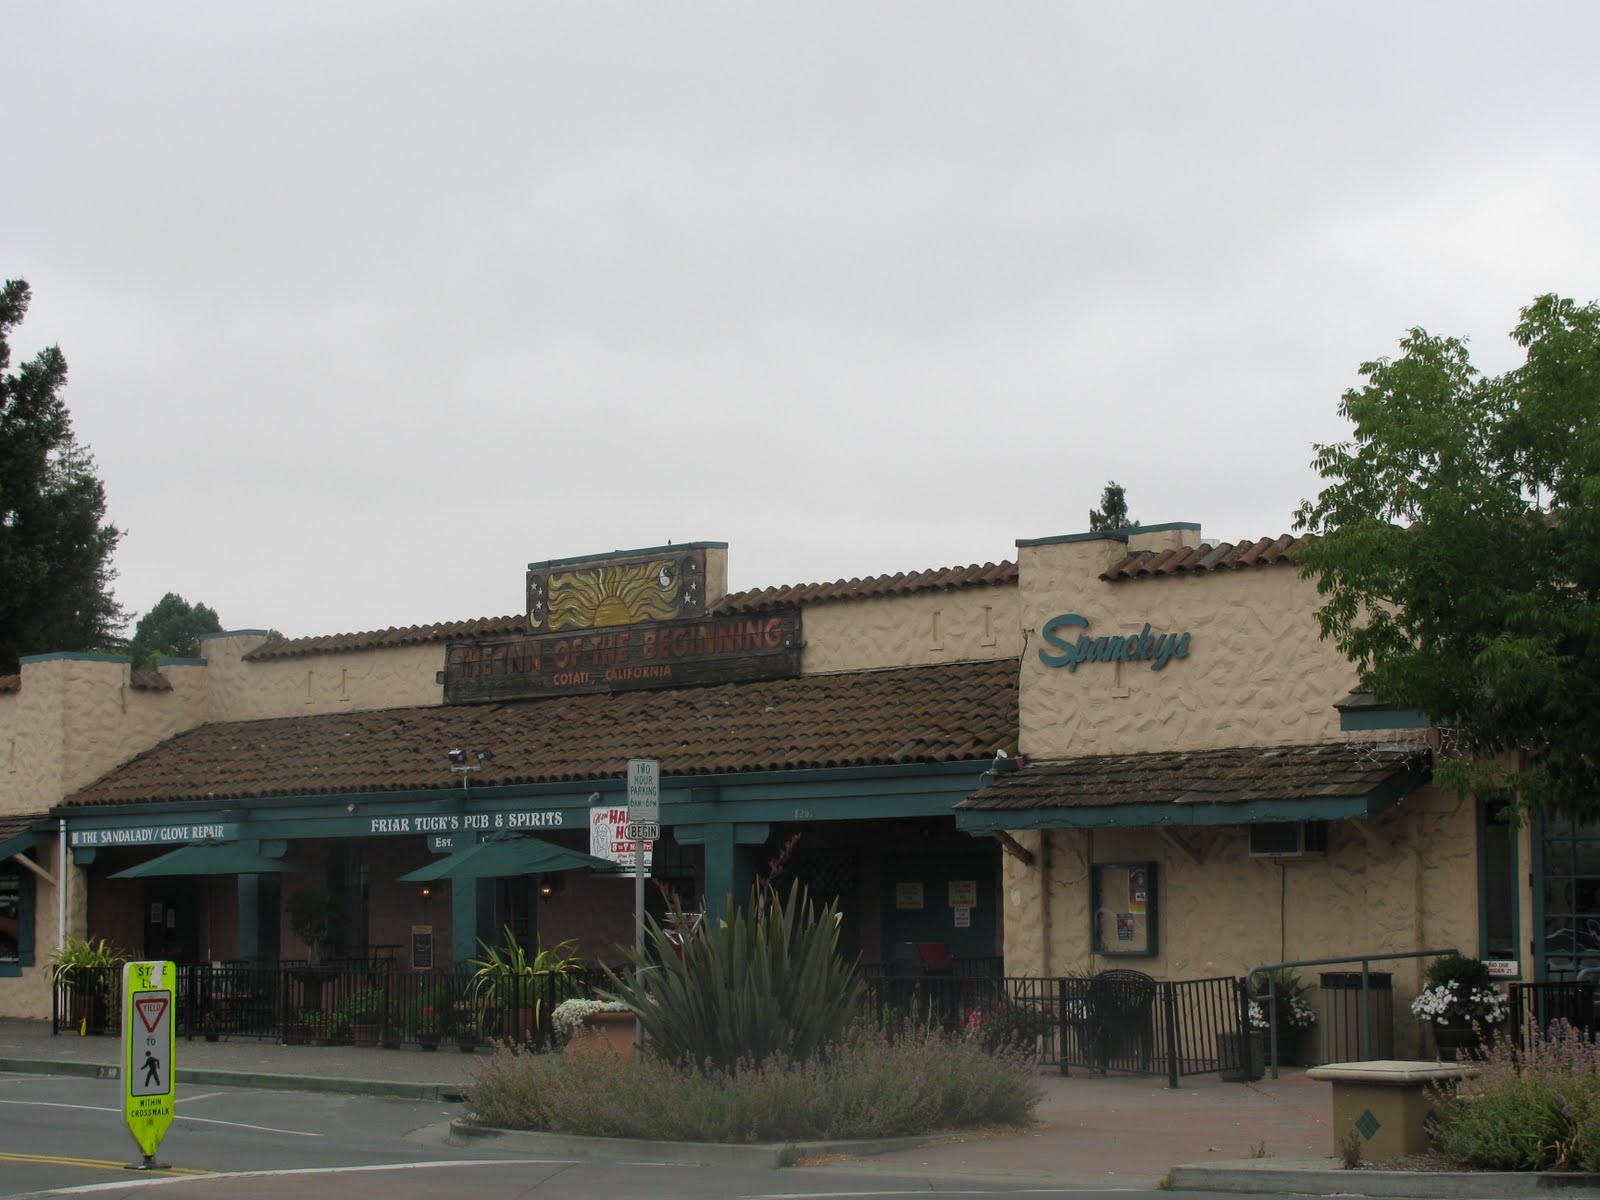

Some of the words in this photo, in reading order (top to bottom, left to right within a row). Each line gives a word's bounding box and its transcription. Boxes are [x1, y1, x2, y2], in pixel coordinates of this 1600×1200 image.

[457, 646, 492, 677] THE
[502, 640, 542, 673] INN
[553, 638, 582, 668] OF
[591, 633, 630, 666] THE
[643, 616, 784, 660] BEGINNING
[605, 665, 672, 681] CALIFORNIA
[637, 764, 651, 774] TWO
[634, 775, 653, 785] HOUR
[630, 786, 657, 796] PARKING
[371, 818, 410, 832] FRIAR
[414, 816, 459, 831] TUCK'S
[464, 815, 489, 829] PUB
[495, 814, 503, 827] &
[509, 811, 563, 827] SPIRITS
[82, 831, 98, 845] THE
[161, 827, 188, 841] GLOVE
[192, 825, 224, 839] REPAIR
[631, 826, 657, 838] BEGIN
[138, 966, 168, 977] STE
[143, 1003, 161, 1012] YIELD
[146, 1038, 156, 1046] TO
[139, 1098, 162, 1107] WITHIN
[131, 1108, 170, 1118] CROSSWALK
